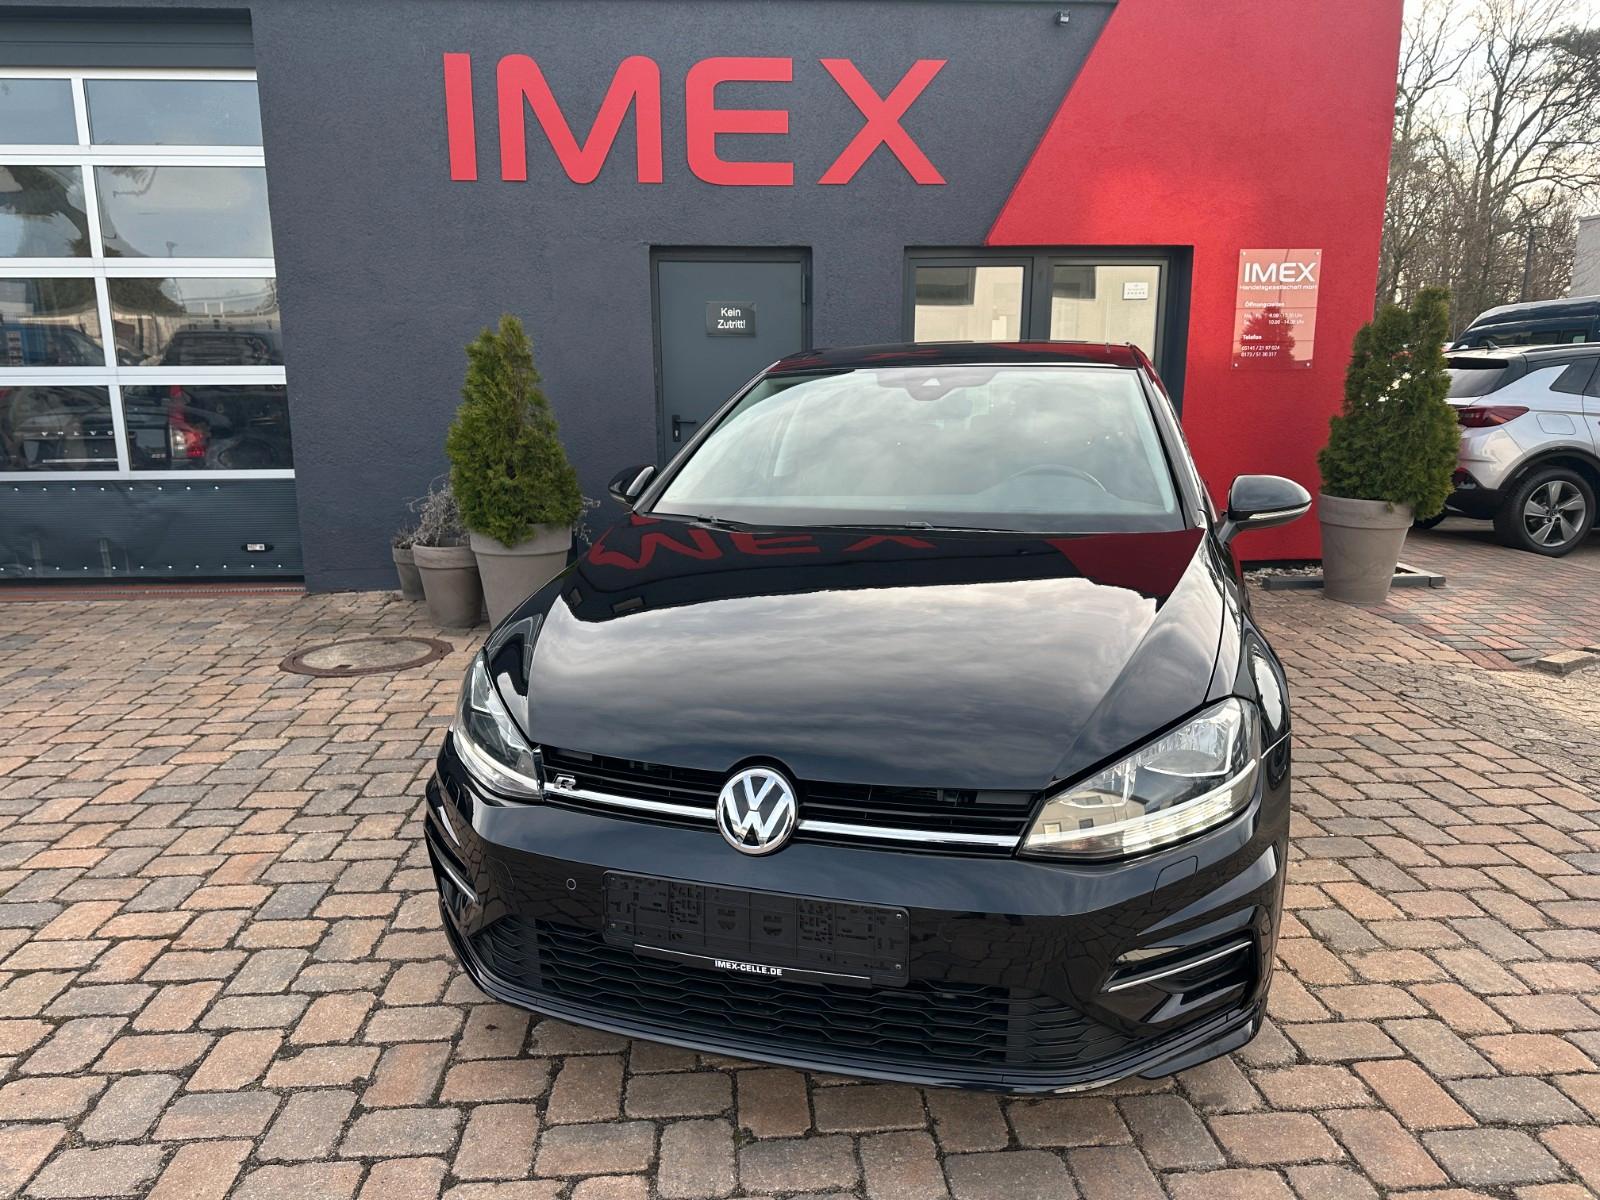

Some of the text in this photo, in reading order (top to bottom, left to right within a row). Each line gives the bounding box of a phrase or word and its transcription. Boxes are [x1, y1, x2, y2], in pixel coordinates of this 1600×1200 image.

[443, 52, 948, 186] IMEX
[1244, 262, 1316, 282] IMEX
[720, 307, 741, 317] Kein
[717, 319, 746, 329] Zutritt!
[553, 773, 577, 791] R
[714, 959, 783, 976] IMEX-CELLE.DE
